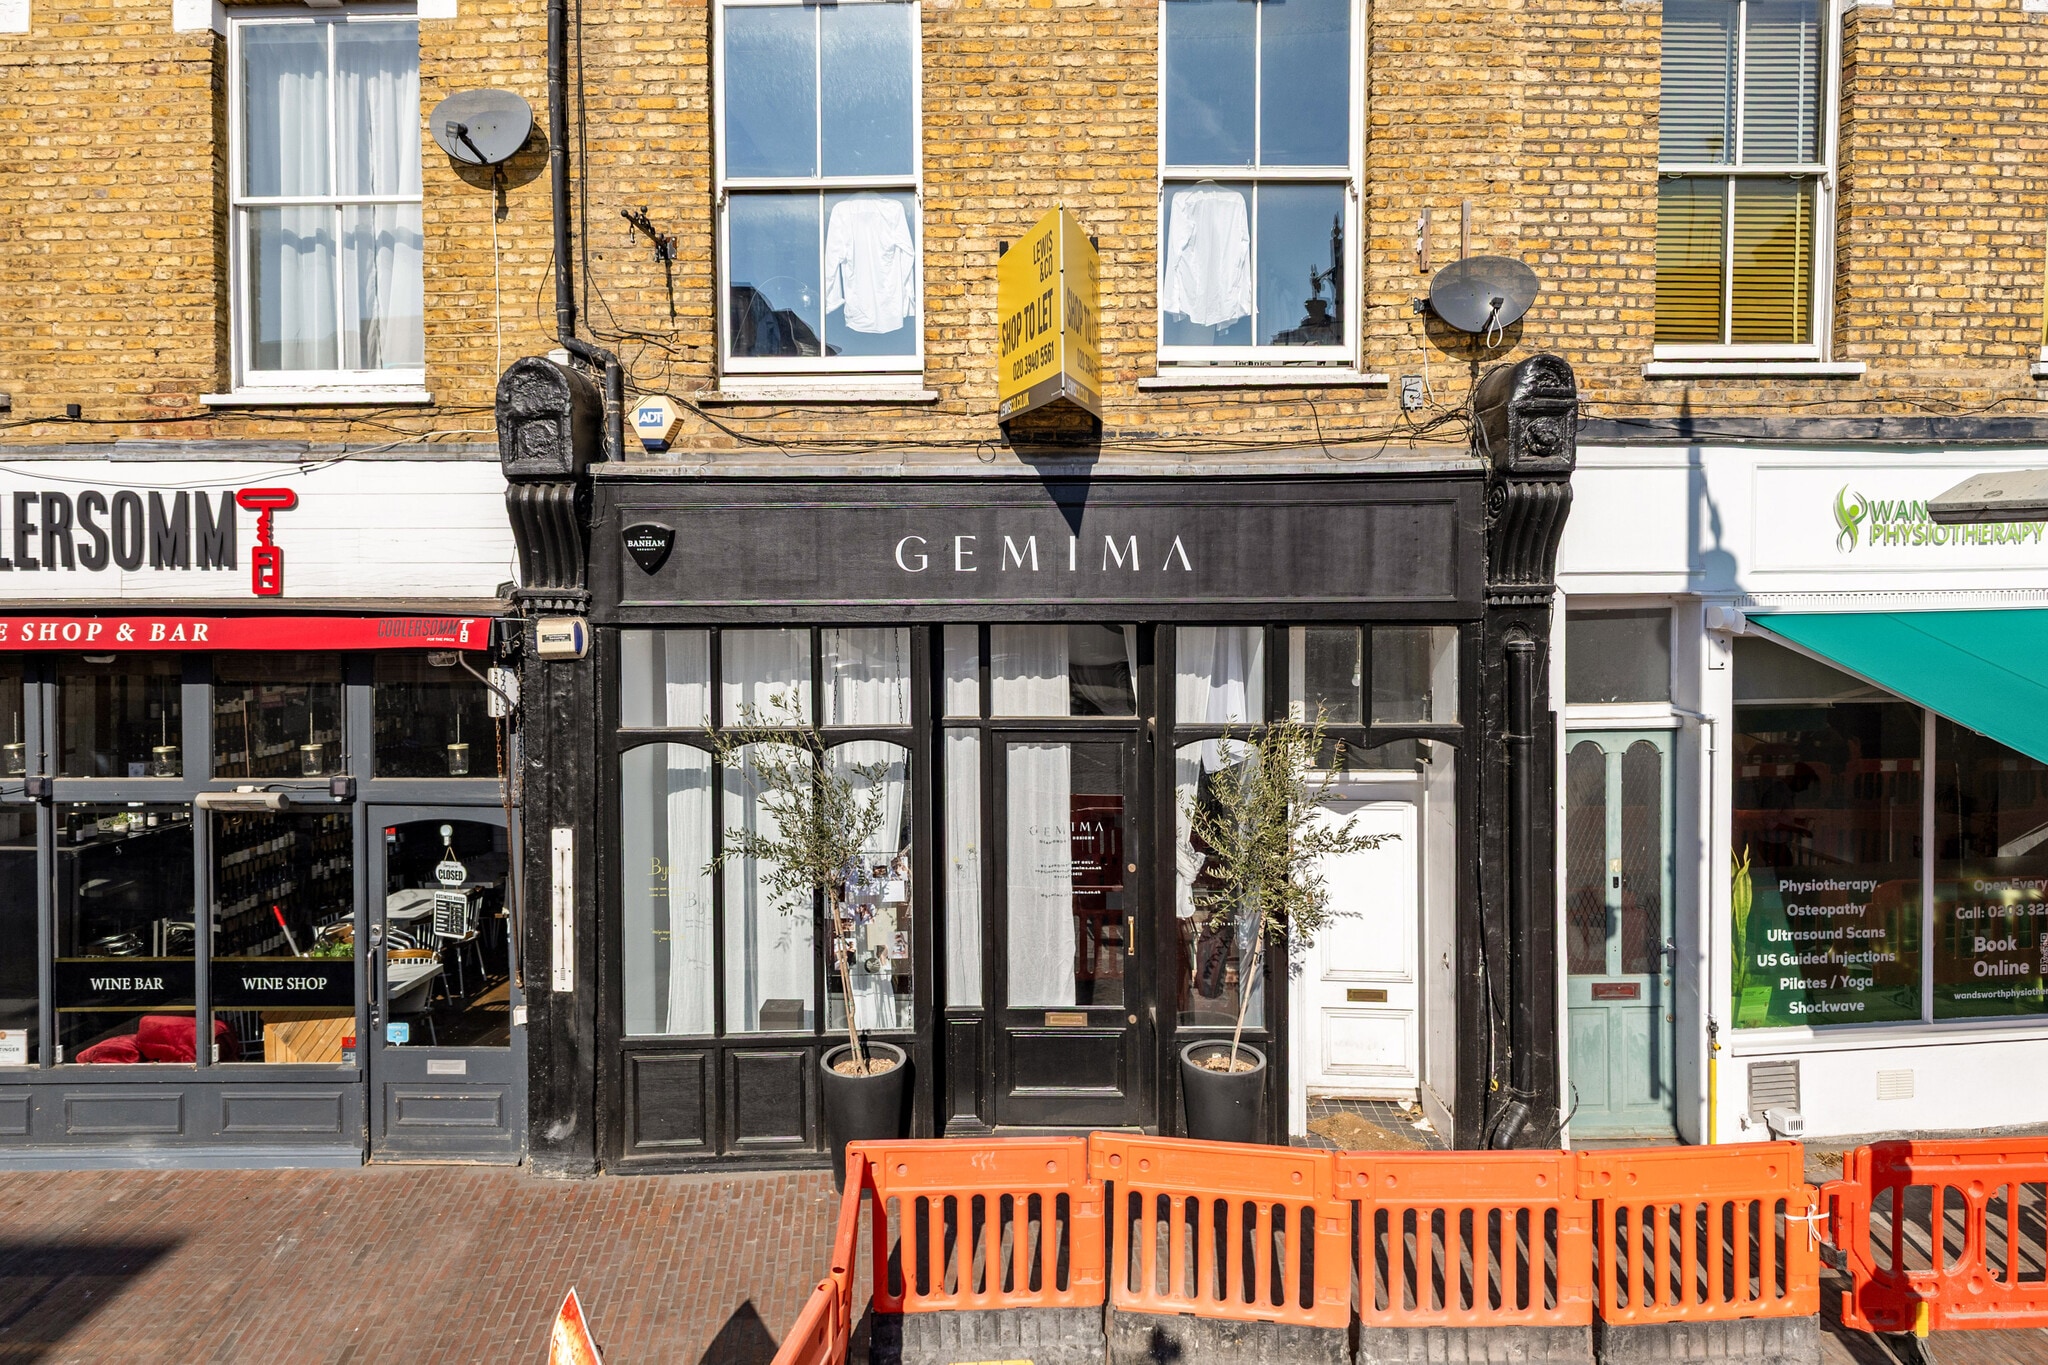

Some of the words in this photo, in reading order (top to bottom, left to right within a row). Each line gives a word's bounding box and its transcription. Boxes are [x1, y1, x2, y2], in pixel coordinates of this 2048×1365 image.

[1033, 230, 1053, 265] LEWIS
[1040, 253, 1053, 283] &CO
[1067, 286, 1083, 336] SHOP
[1002, 311, 1022, 357] SHOP
[1024, 301, 1035, 343] TO
[1037, 287, 1053, 335] LET
[1013, 358, 1024, 381] 020
[1024, 349, 1039, 375] 3940
[1040, 340, 1054, 367] 5561
[639, 411, 663, 424] ADT
[1871, 522, 2047, 544] PHYSIOTHERAPY
[895, 535, 1192, 572] GEMIMA
[21, 623, 103, 641] SHOP
[116, 623, 136, 641] &
[149, 623, 209, 641] BAR
[378, 619, 461, 637] COOLERSOMM
[438, 869, 463, 880] CLOSED
[1779, 879, 1877, 895] Physiotherapy
[1974, 879, 2008, 894] Open
[1787, 903, 1866, 918] Osteopathy
[1956, 906, 1985, 919] Call:
[1988, 904, 2024, 918] 0203
[1767, 927, 1843, 941] Ultrasound
[1846, 926, 1886, 939] Scans
[1974, 935, 2017, 952] Book
[1757, 953, 1777, 967] US
[1780, 952, 1828, 966] Guided
[1831, 950, 1896, 967] Injections
[1973, 960, 2030, 977] Online
[90, 977, 131, 990] WINE
[135, 977, 164, 990] BAR
[242, 976, 283, 990] WINE
[287, 976, 327, 990] SHOP
[1780, 976, 1827, 990] Pilates
[1830, 975, 1837, 989] /
[1840, 975, 1873, 991] Yoga
[1789, 1000, 1865, 1014] Shockwave
